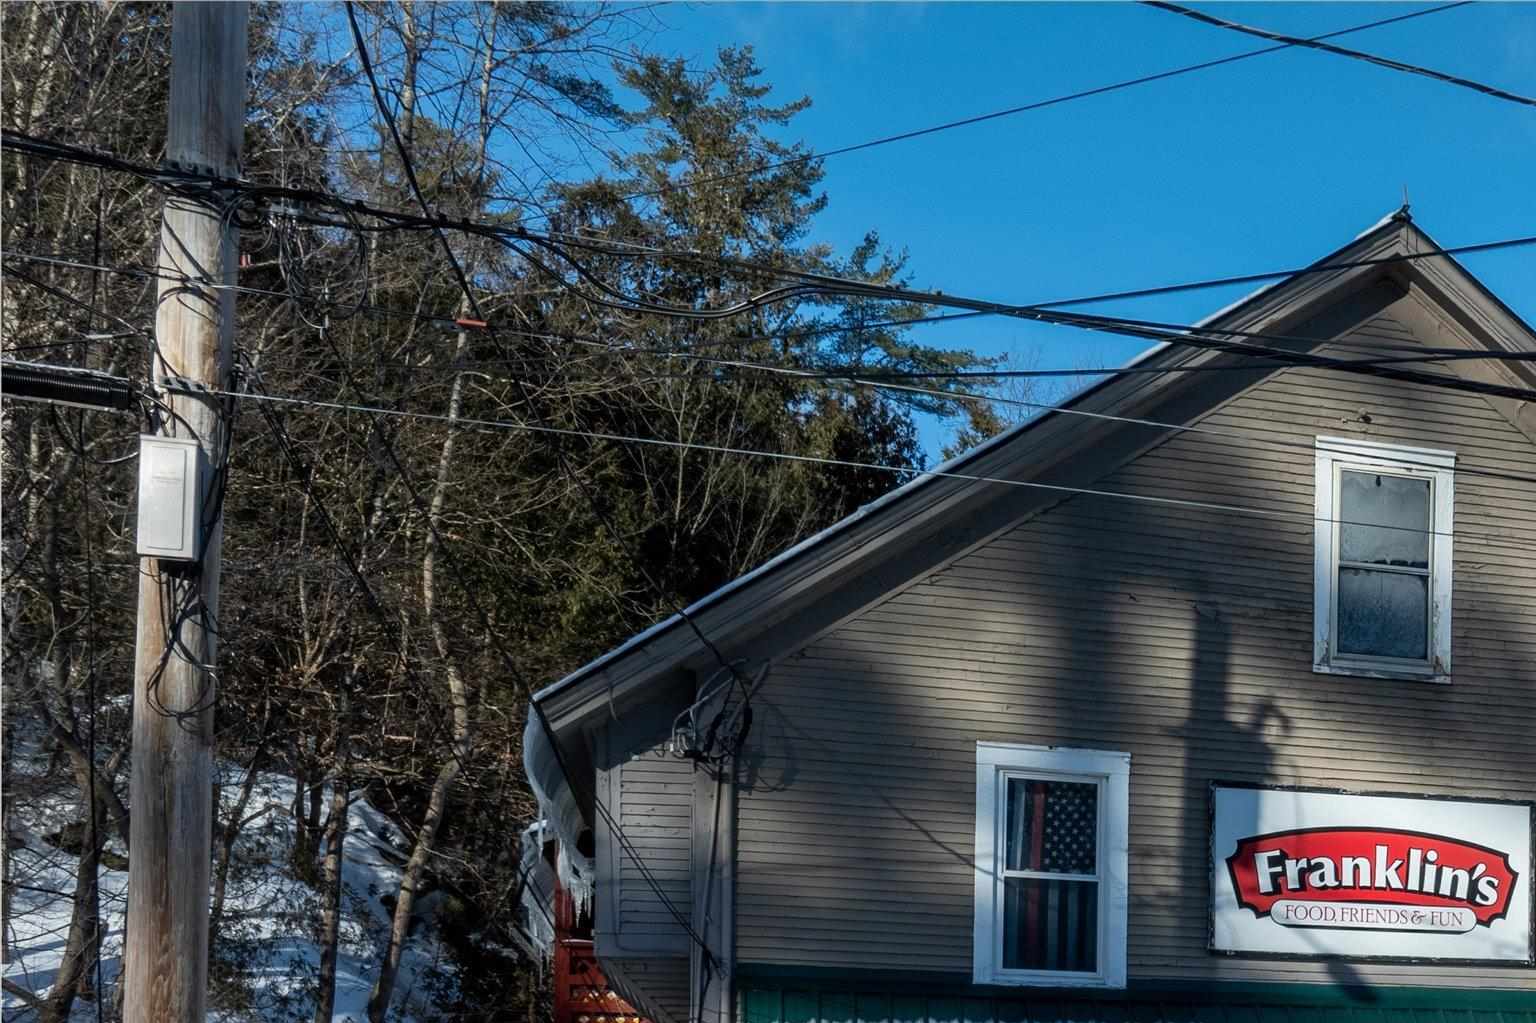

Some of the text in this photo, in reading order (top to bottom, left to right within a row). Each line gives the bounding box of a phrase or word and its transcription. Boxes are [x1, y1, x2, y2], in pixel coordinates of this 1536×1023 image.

[1254, 844, 1499, 906] Franklin's
[1284, 904, 1463, 926] FOOD, FRIENDS & FUN
